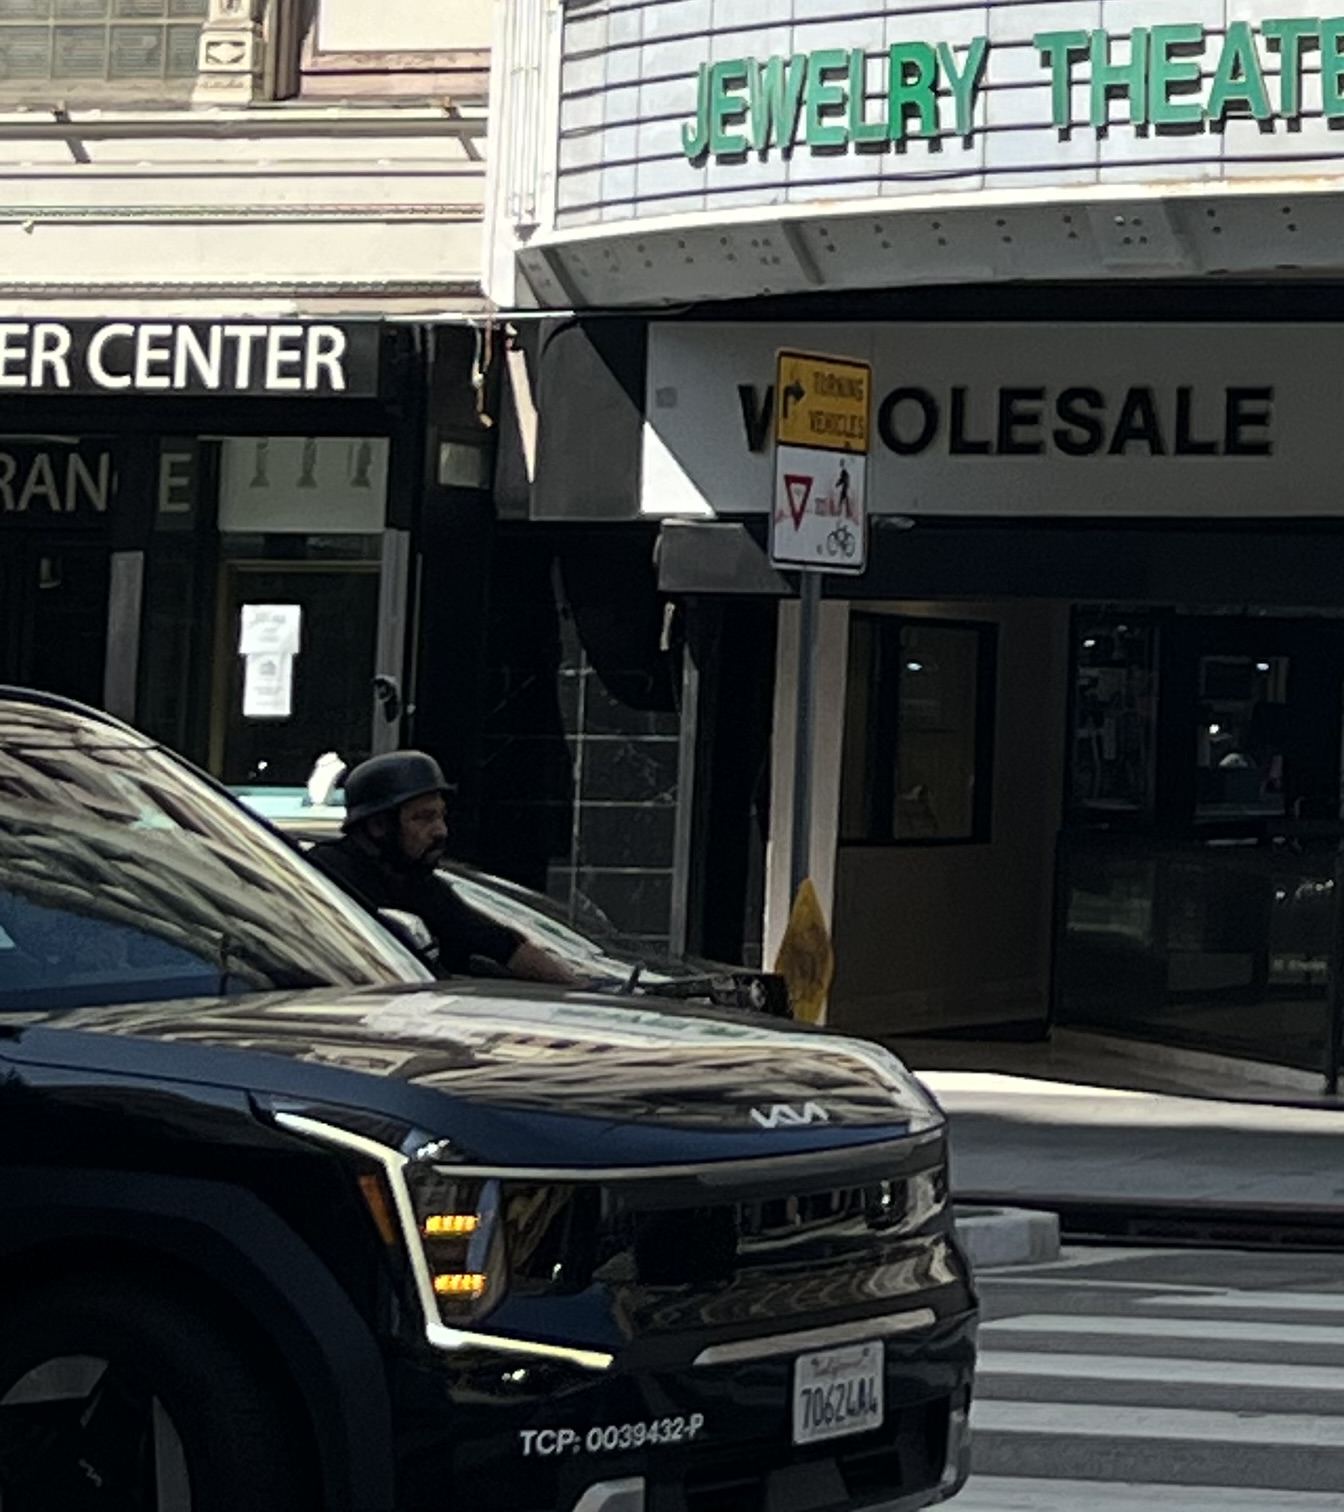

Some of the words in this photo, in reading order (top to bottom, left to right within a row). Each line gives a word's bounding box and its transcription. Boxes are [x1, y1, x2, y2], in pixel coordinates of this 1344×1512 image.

[681, 36, 988, 160] JEWELRY
[87, 322, 347, 391] CENTER
[0, 451, 192, 513] RANE
[519, 1428, 581, 1457] TCP:
[585, 1411, 705, 1453] 0039432-P
